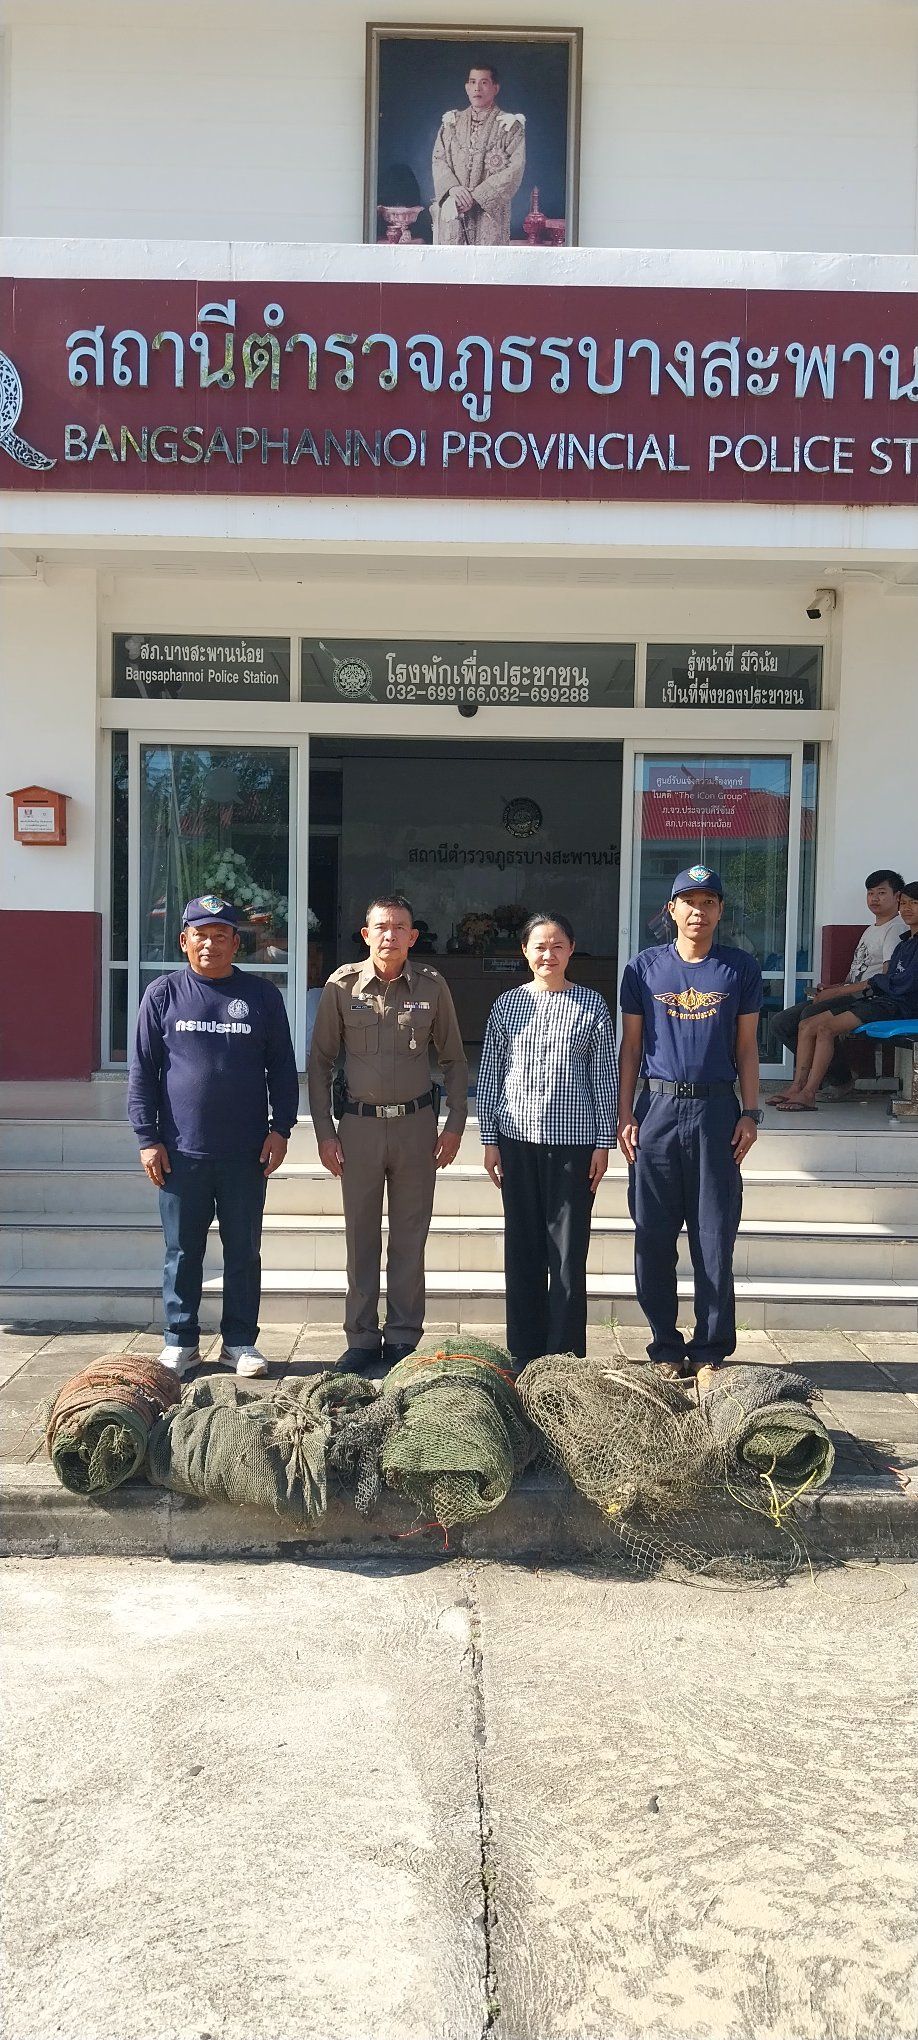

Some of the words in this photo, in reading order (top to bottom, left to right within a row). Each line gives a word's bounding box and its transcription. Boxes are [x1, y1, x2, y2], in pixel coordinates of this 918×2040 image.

[66, 298, 918, 423] สถานีตำรวจภูธรบางสะพาน
[64, 424, 427, 467] BANGSAPHANNOI
[442, 430, 690, 471] PROVINCIAL
[708, 434, 856, 474] POLICE
[869, 437, 918, 475] ST
[140, 640, 265, 664] สภ.บางสะพานน้อย
[687, 645, 735, 679] รู้หน้าที่
[740, 649, 778, 672] มีวินัย
[125, 666, 204, 684] Bangsaphannoi
[208, 669, 239, 684] Police
[243, 670, 279, 684] Station
[385, 649, 590, 687] โรงพักเพื่อประชาชน
[386, 684, 590, 702] 032-699166,032-699288
[662, 678, 805, 705] เป็นที่พึ่งของประชาชน
[697, 791, 715, 800] iCon
[175, 1019, 252, 1035] กรมประมง
